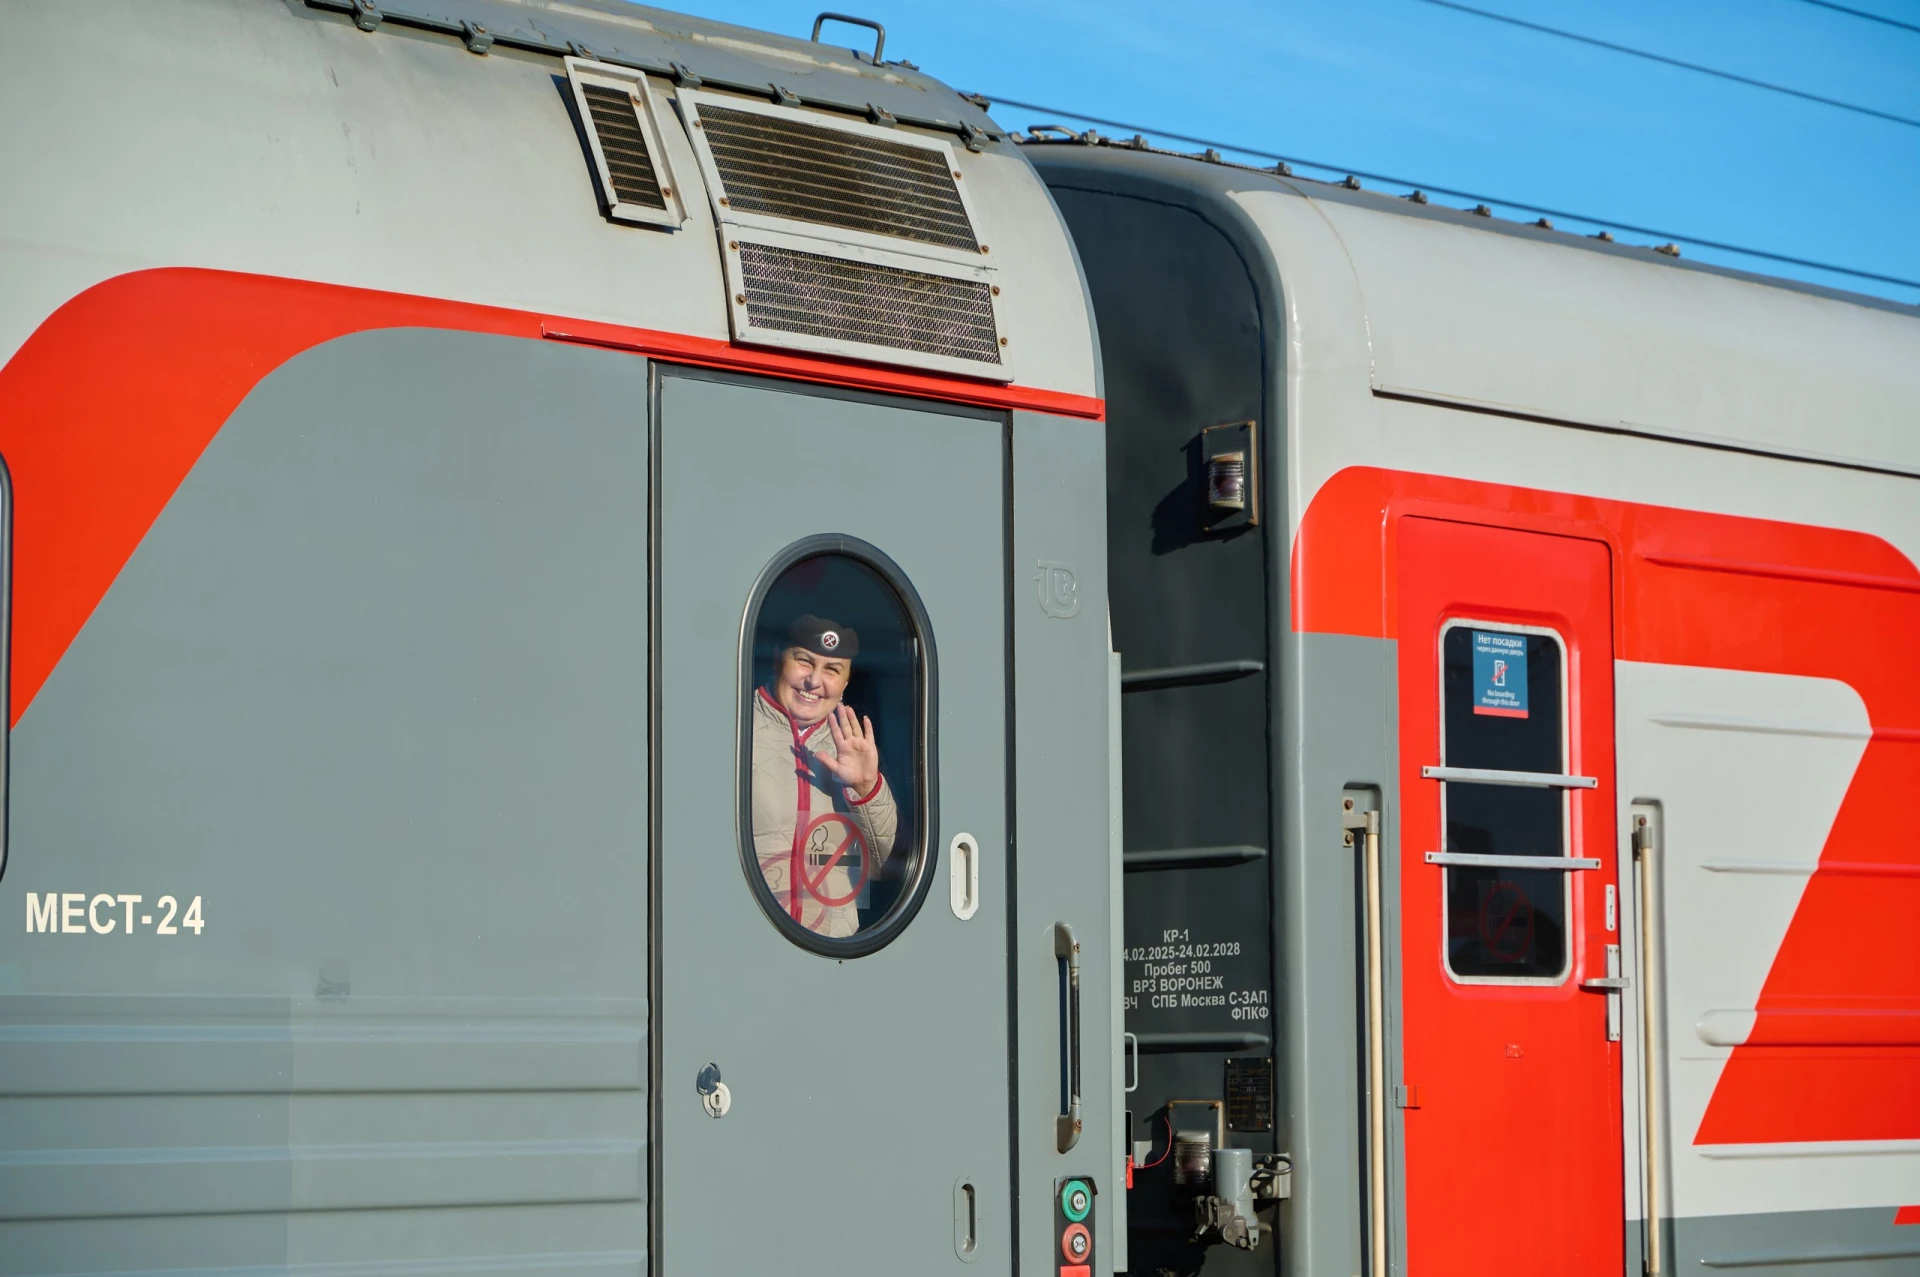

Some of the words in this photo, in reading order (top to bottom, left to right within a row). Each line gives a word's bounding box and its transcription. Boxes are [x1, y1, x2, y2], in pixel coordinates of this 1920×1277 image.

[1478, 634, 1491, 645] Нет
[1492, 637, 1523, 649] посадки
[1491, 647, 1509, 656] данную
[1509, 649, 1524, 657] дверь
[1482, 697, 1500, 706] through
[1495, 689, 1515, 700] boarding
[26, 893, 205, 935] МЕСТ-24
[1163, 928, 1189, 943] КР-1
[1144, 961, 1188, 979] Пробег
[1190, 960, 1211, 974] 500
[1133, 979, 1157, 993] ВРЗ
[1160, 976, 1224, 992] ВОРОНЕЖ
[1151, 994, 1178, 1008] СПБ
[1181, 993, 1226, 1008] Москва
[1229, 990, 1268, 1005] С-ЗАП
[1231, 1005, 1270, 1020] ФПКФ
